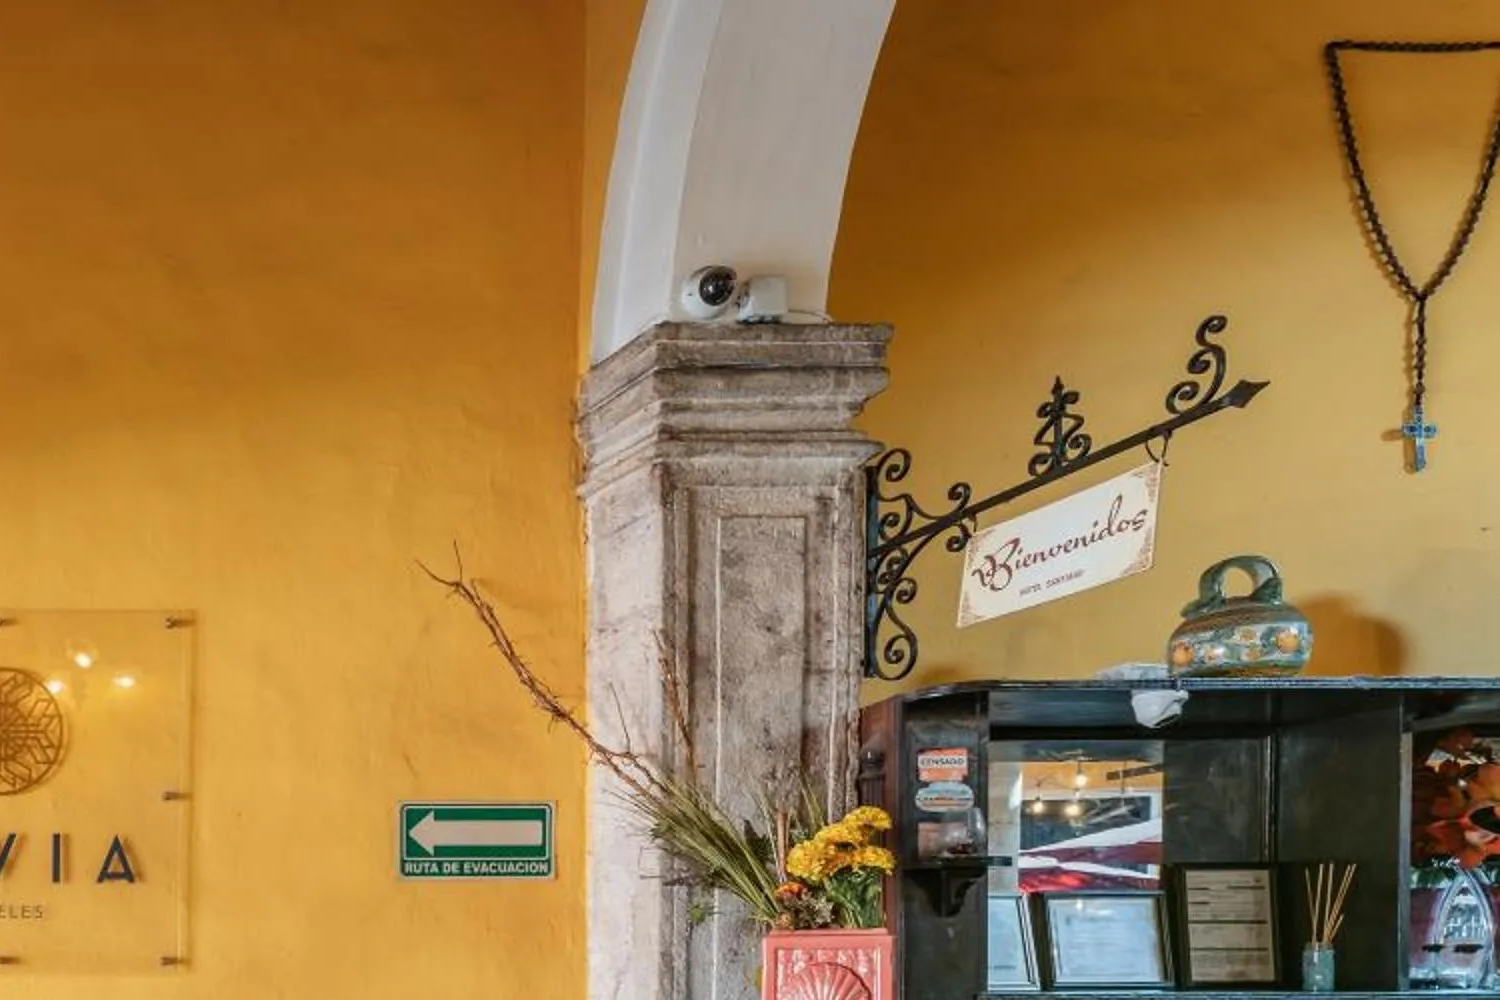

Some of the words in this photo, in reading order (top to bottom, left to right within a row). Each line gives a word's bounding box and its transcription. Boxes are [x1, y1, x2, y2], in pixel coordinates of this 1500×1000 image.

[971, 494, 1148, 592] Bienvenidos
[404, 862, 440, 874] RUTA
[443, 862, 461, 873] DE
[463, 861, 549, 873] EVACUACION
